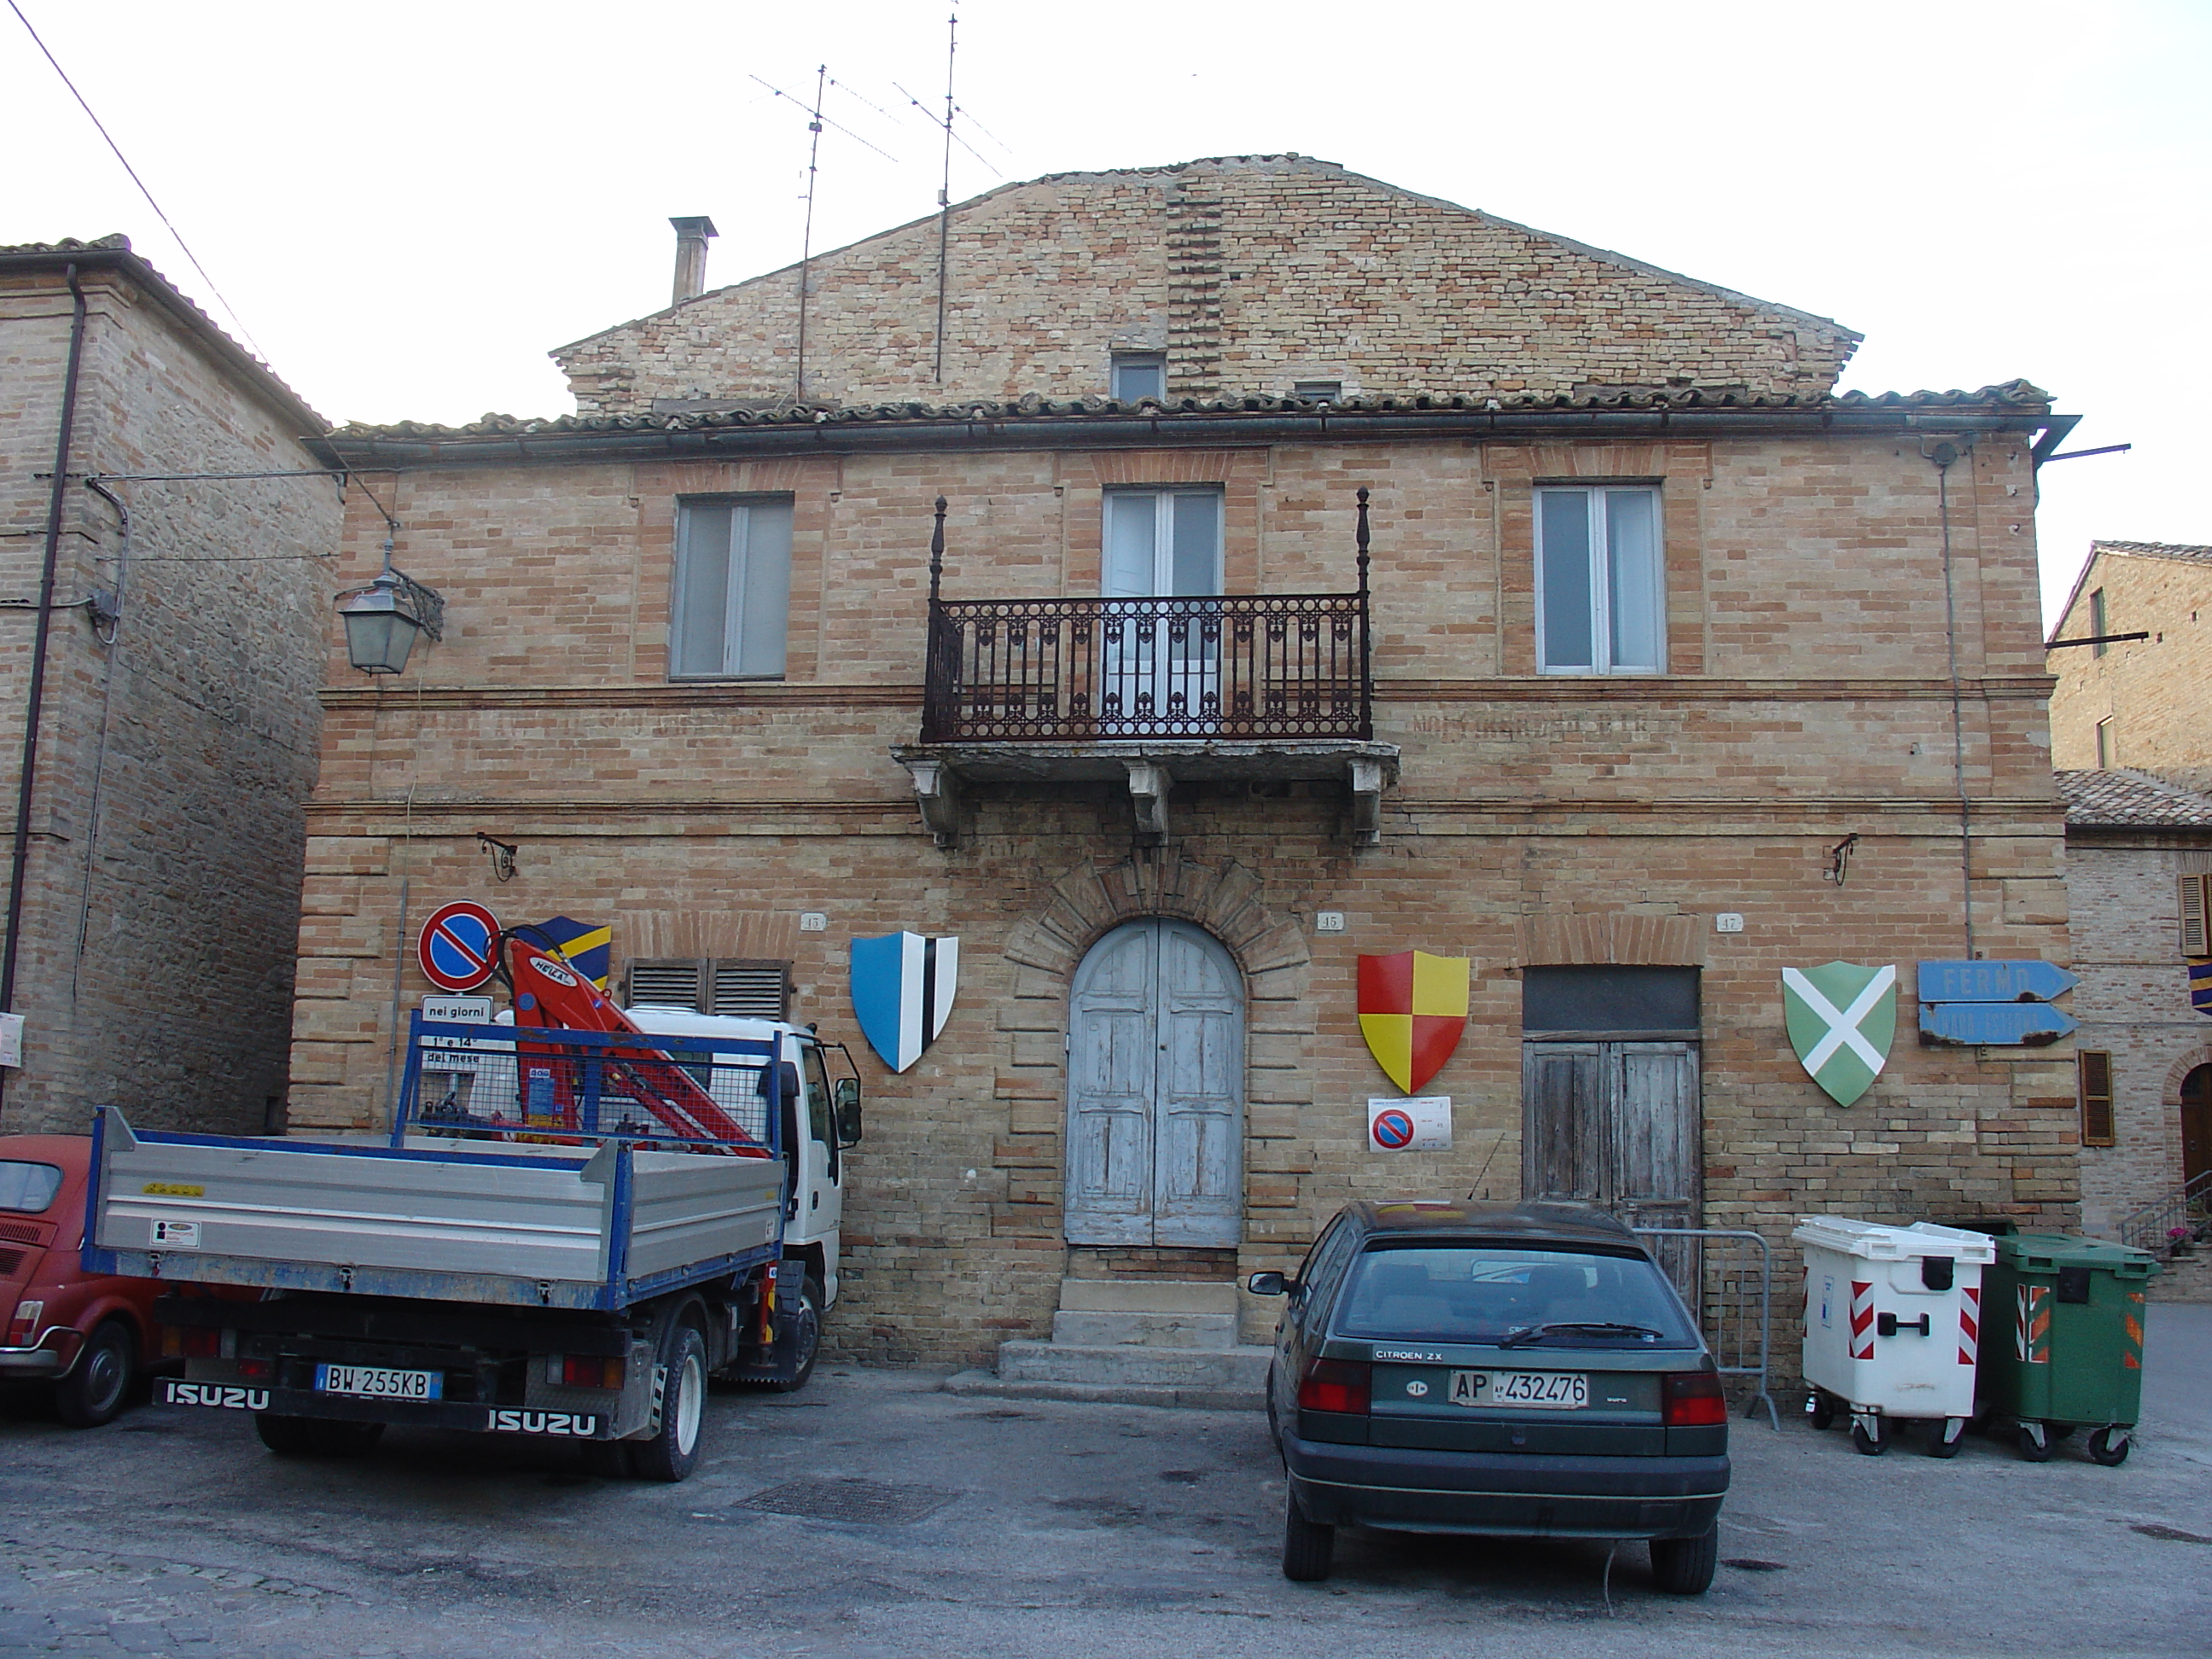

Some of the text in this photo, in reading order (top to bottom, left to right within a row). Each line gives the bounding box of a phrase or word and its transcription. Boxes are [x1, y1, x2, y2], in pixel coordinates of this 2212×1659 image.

[1324, 917, 1337, 927] 45
[1723, 917, 1736, 928] 47
[429, 1006, 485, 1018] nei giorni
[428, 1052, 480, 1062] del mese
[329, 1367, 427, 1396] BW 255KB
[1456, 1374, 1487, 1398] AP
[1505, 1375, 1586, 1401] 432476
[166, 1382, 270, 1410] ISUZU
[488, 1409, 596, 1435] ISUZU
